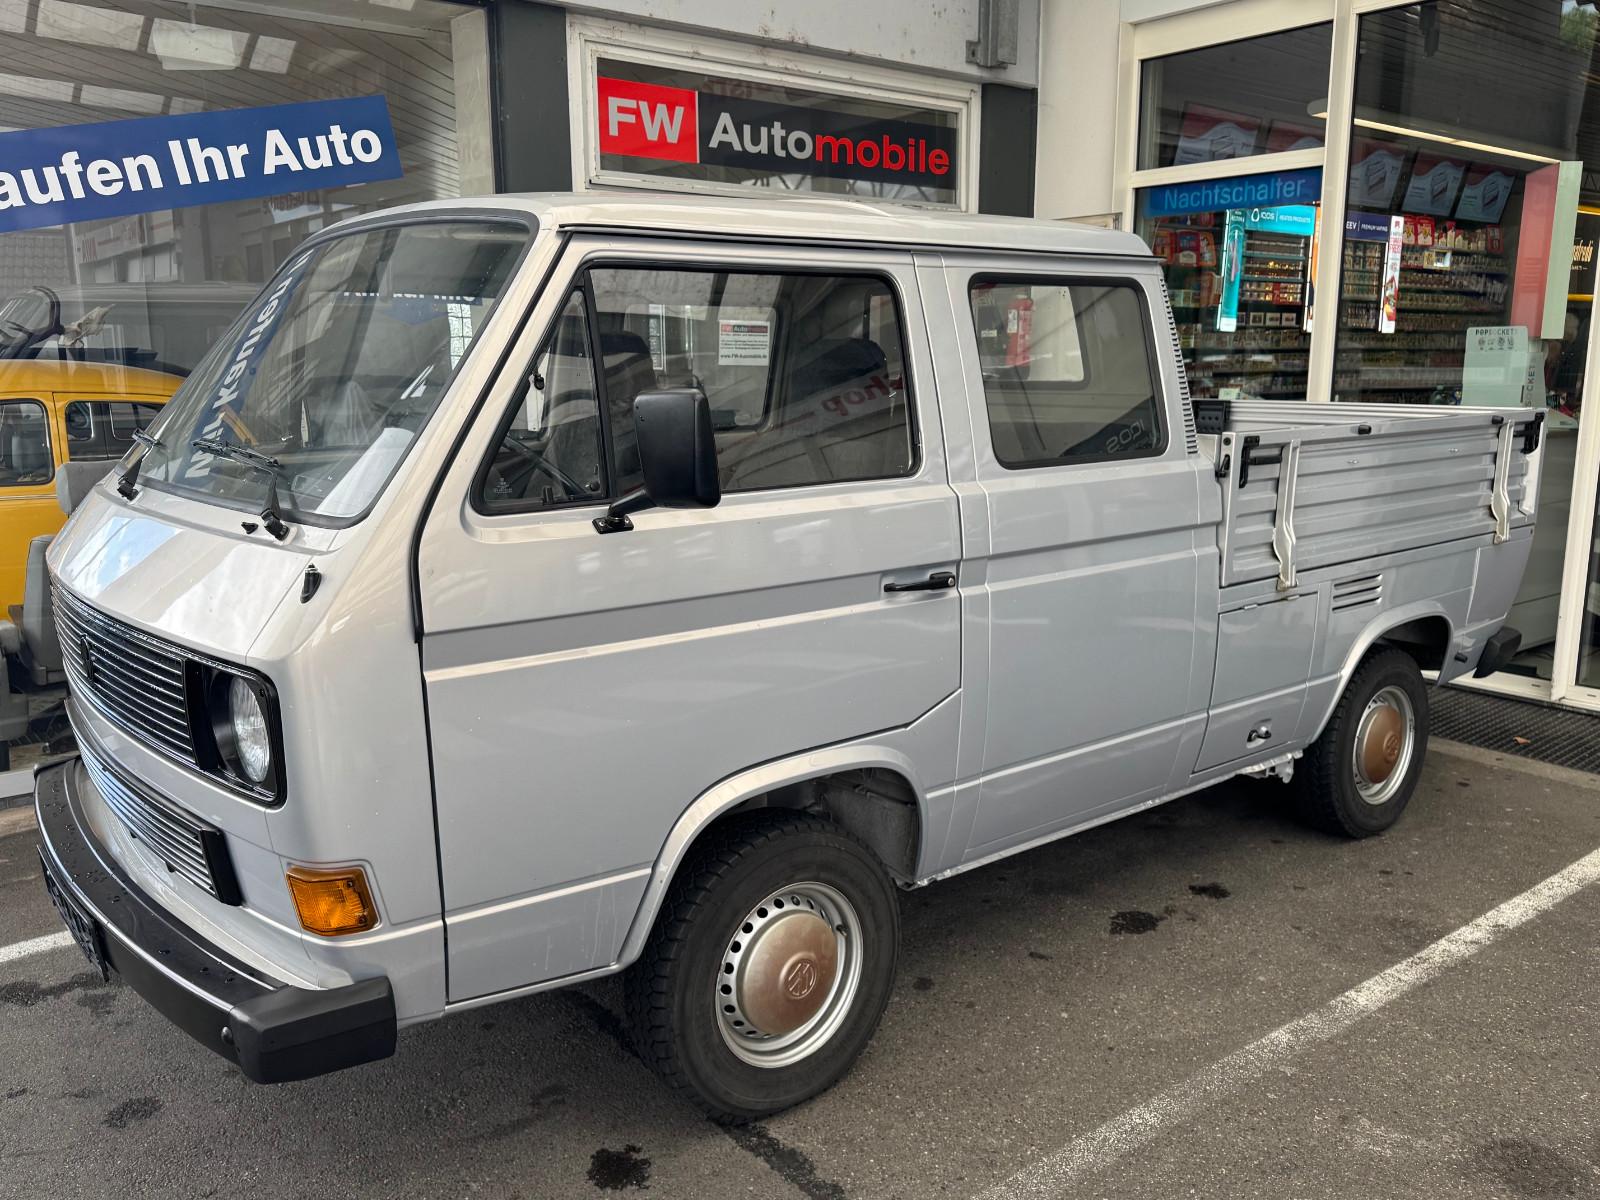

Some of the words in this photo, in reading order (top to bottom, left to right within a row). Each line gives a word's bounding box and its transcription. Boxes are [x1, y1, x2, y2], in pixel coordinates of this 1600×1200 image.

[168, 137, 249, 186] Ihr
[263, 124, 383, 175] Auto
[607, 96, 685, 145] FW
[708, 111, 951, 175] Automobile
[1164, 178, 1306, 210] Nachtschalter
